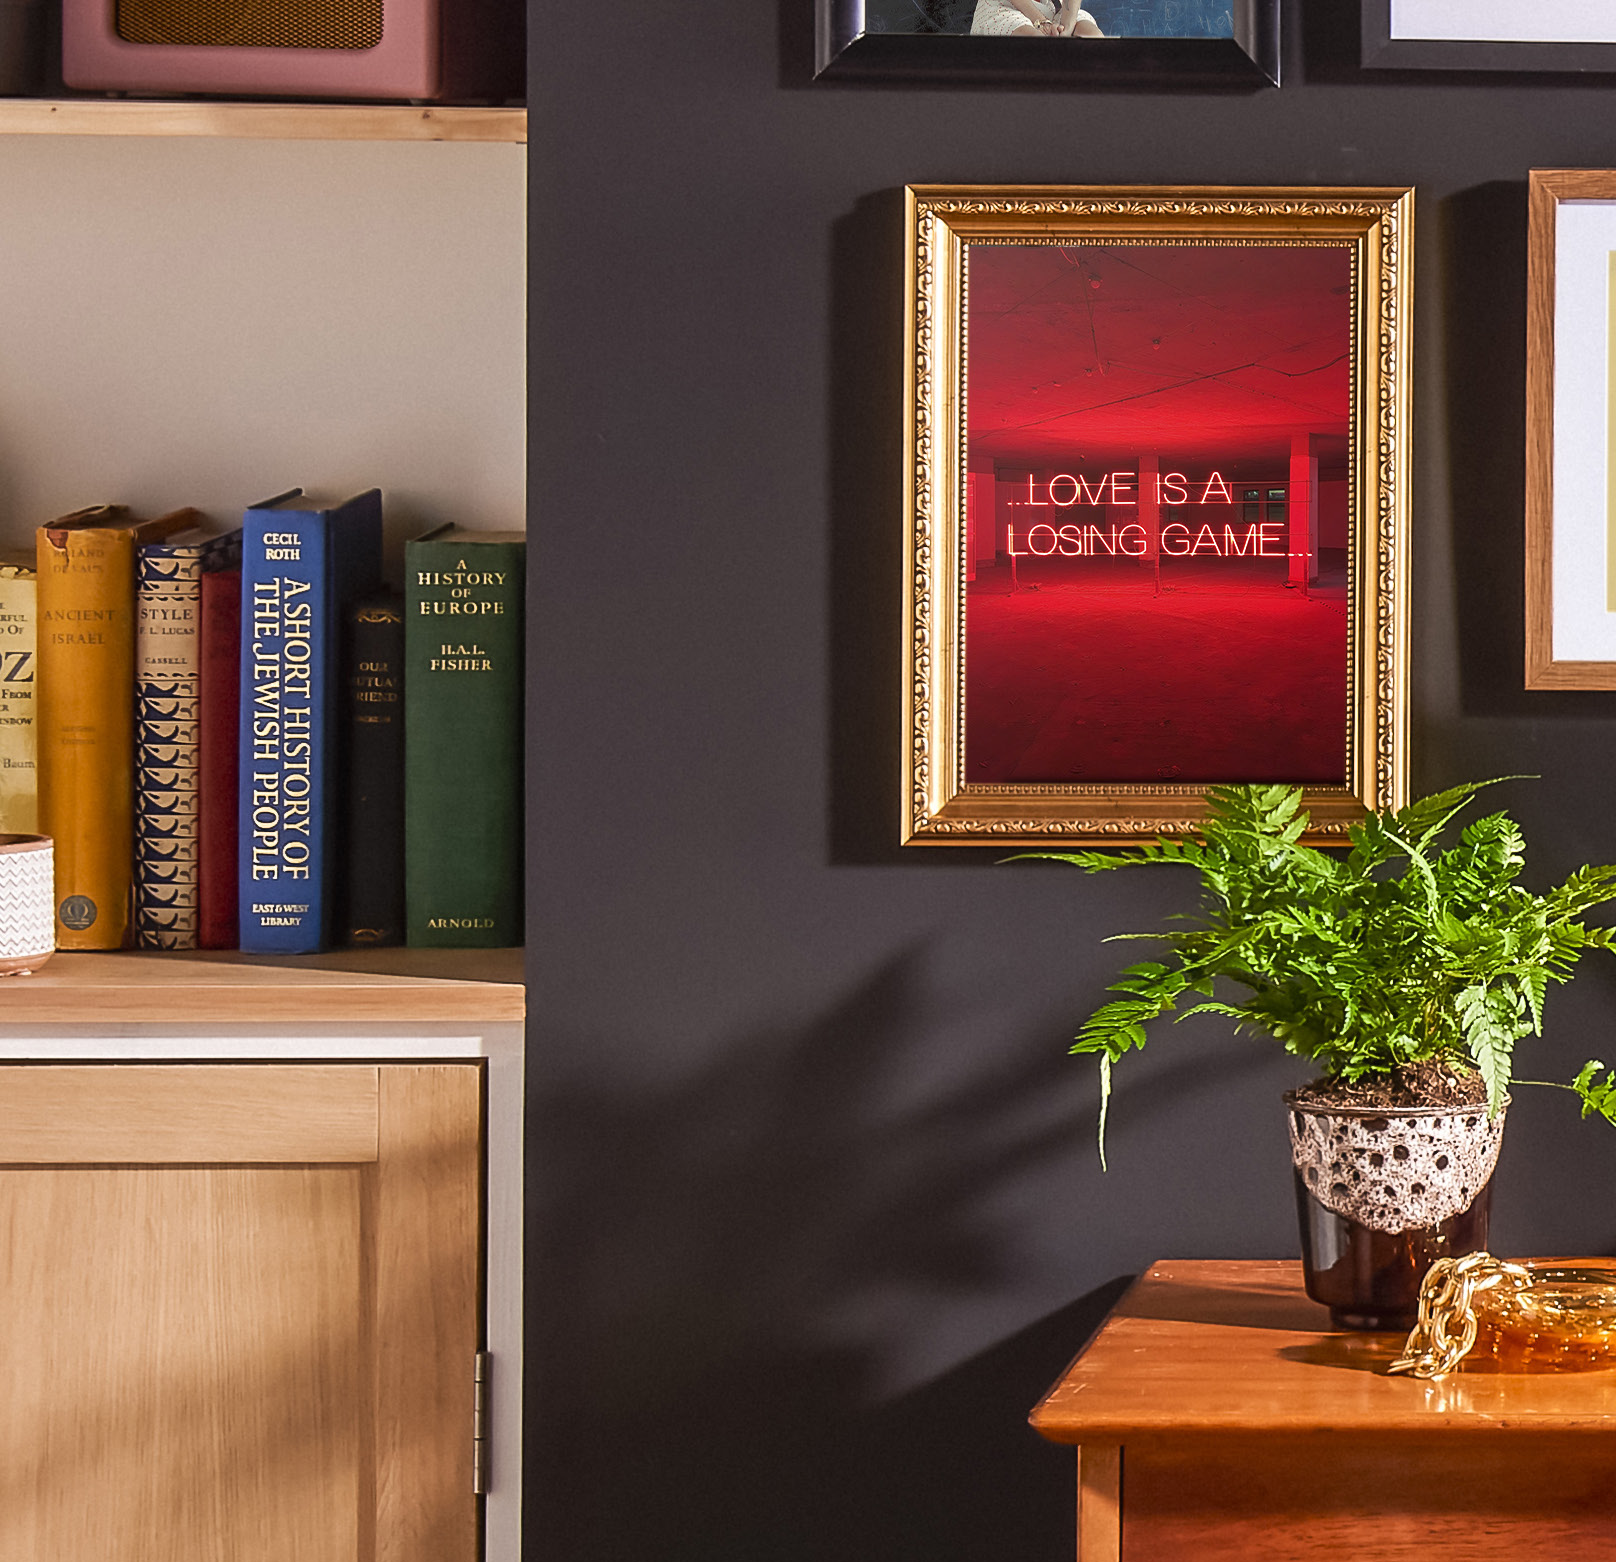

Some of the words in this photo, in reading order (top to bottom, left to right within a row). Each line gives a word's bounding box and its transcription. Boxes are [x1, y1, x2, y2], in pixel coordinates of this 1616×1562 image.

[1156, 471, 1187, 505] IS
[1199, 471, 1232, 505] A
[263, 532, 302, 545] CECIL
[1007, 523, 1147, 556] LOSING
[265, 547, 301, 561] ROTH
[456, 559, 467, 571] A
[417, 571, 507, 586] HISTORY
[283, 577, 311, 598] A
[451, 587, 472, 599] OF
[140, 608, 194, 621] STYLE
[253, 577, 280, 639] THE
[419, 601, 505, 615] EUROPE
[44, 610, 116, 621] ANCIENT
[162, 627, 195, 635] LUCAS
[52, 633, 106, 645] ISRAEL
[283, 601, 311, 699] SHORT
[430, 657, 494, 672] FISHER
[252, 642, 280, 760] JEWISH
[282, 706, 311, 837] HISTORY
[251, 773, 279, 881] PEOPLE
[282, 841, 310, 880] OF
[260, 917, 302, 926] LIBRARY
[427, 917, 495, 930] ARNOLD
